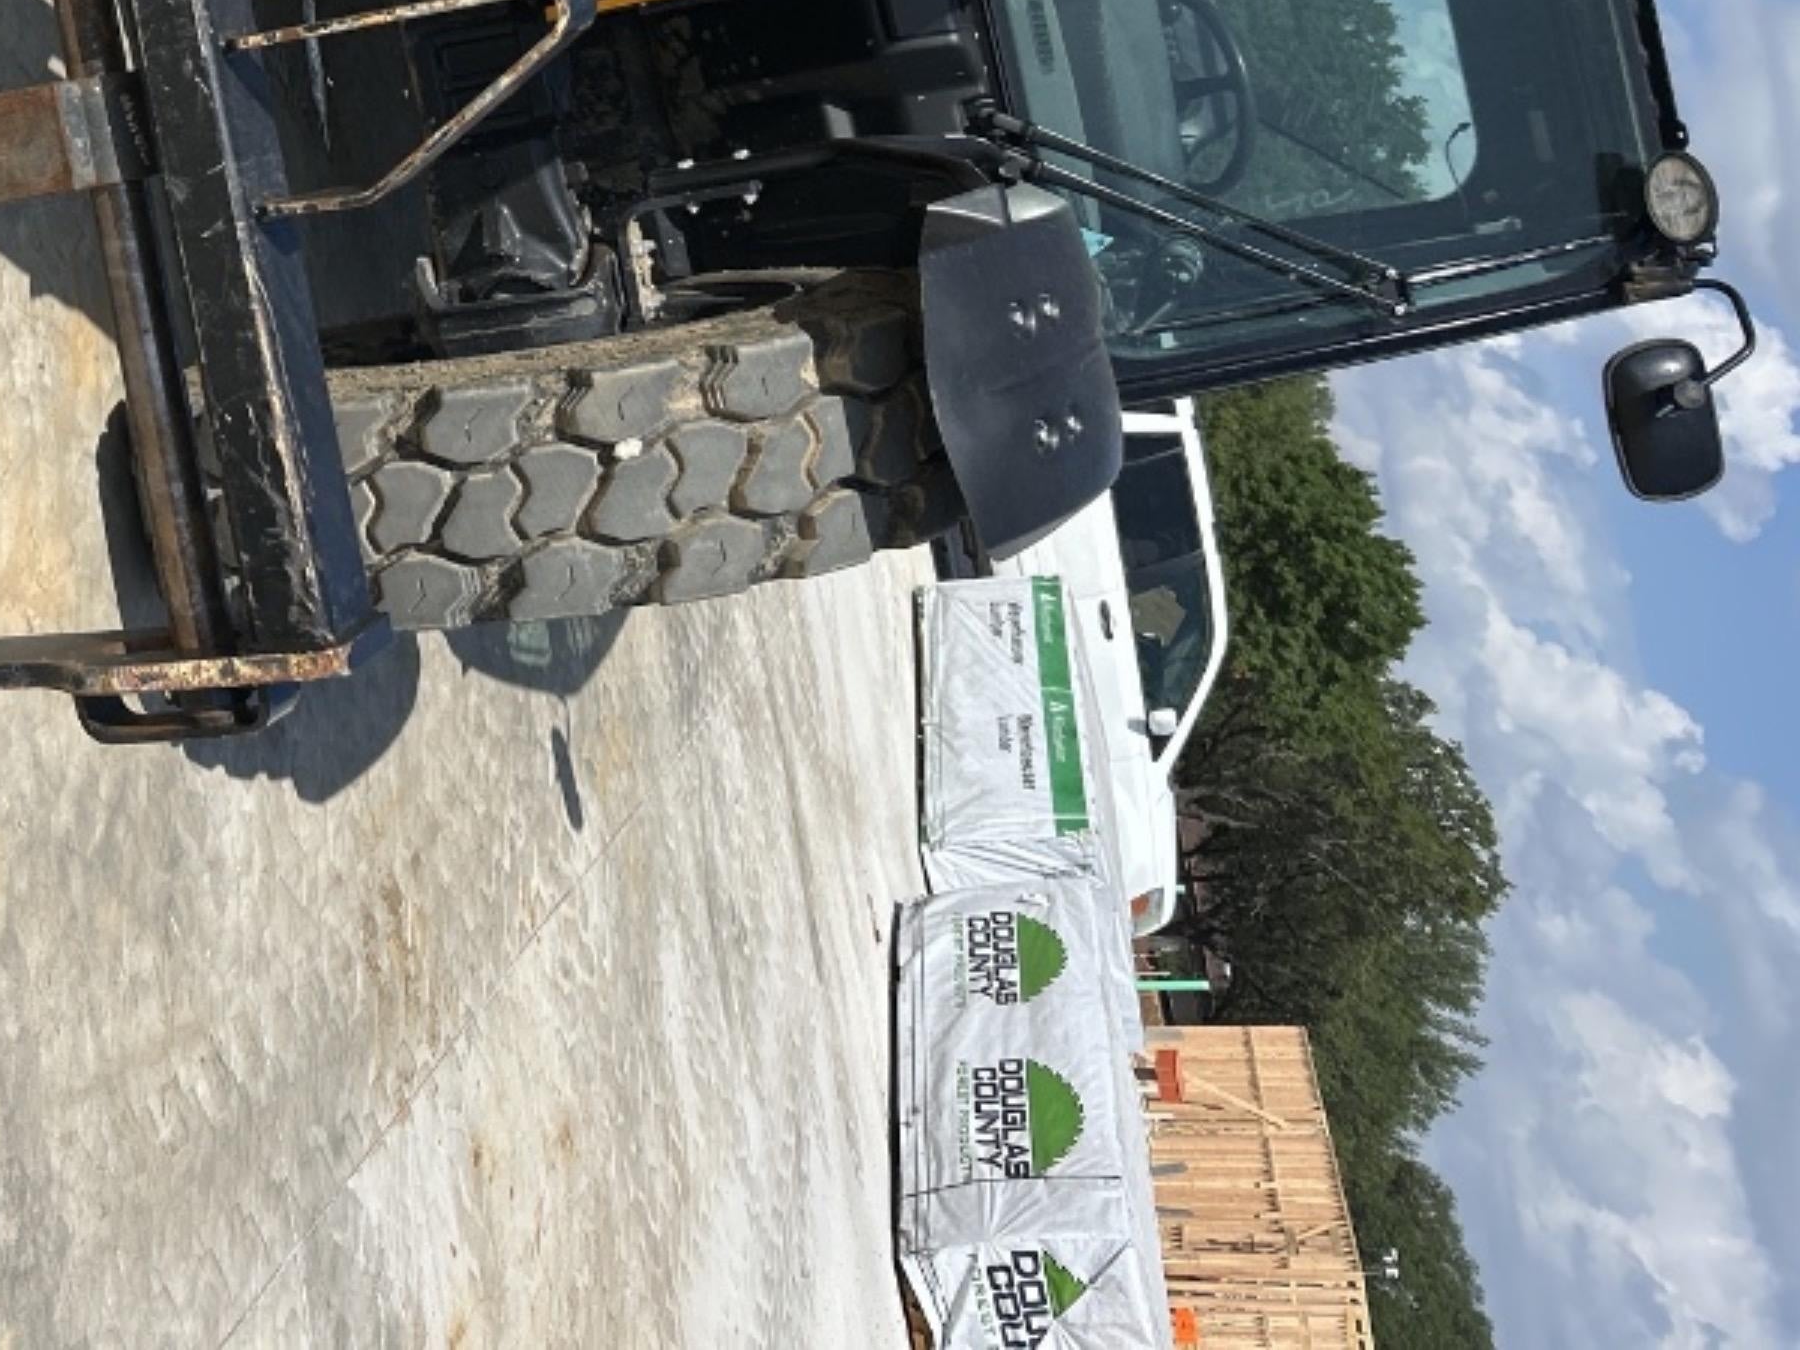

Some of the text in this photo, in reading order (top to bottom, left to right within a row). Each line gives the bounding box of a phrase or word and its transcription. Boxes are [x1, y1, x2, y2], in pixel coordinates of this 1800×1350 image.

[967, 917, 994, 999] COUNTY
[990, 911, 1019, 1006] DOUGLAS
[972, 1067, 1003, 1170] COUNTY
[999, 1058, 1030, 1179] DOUGLAS
